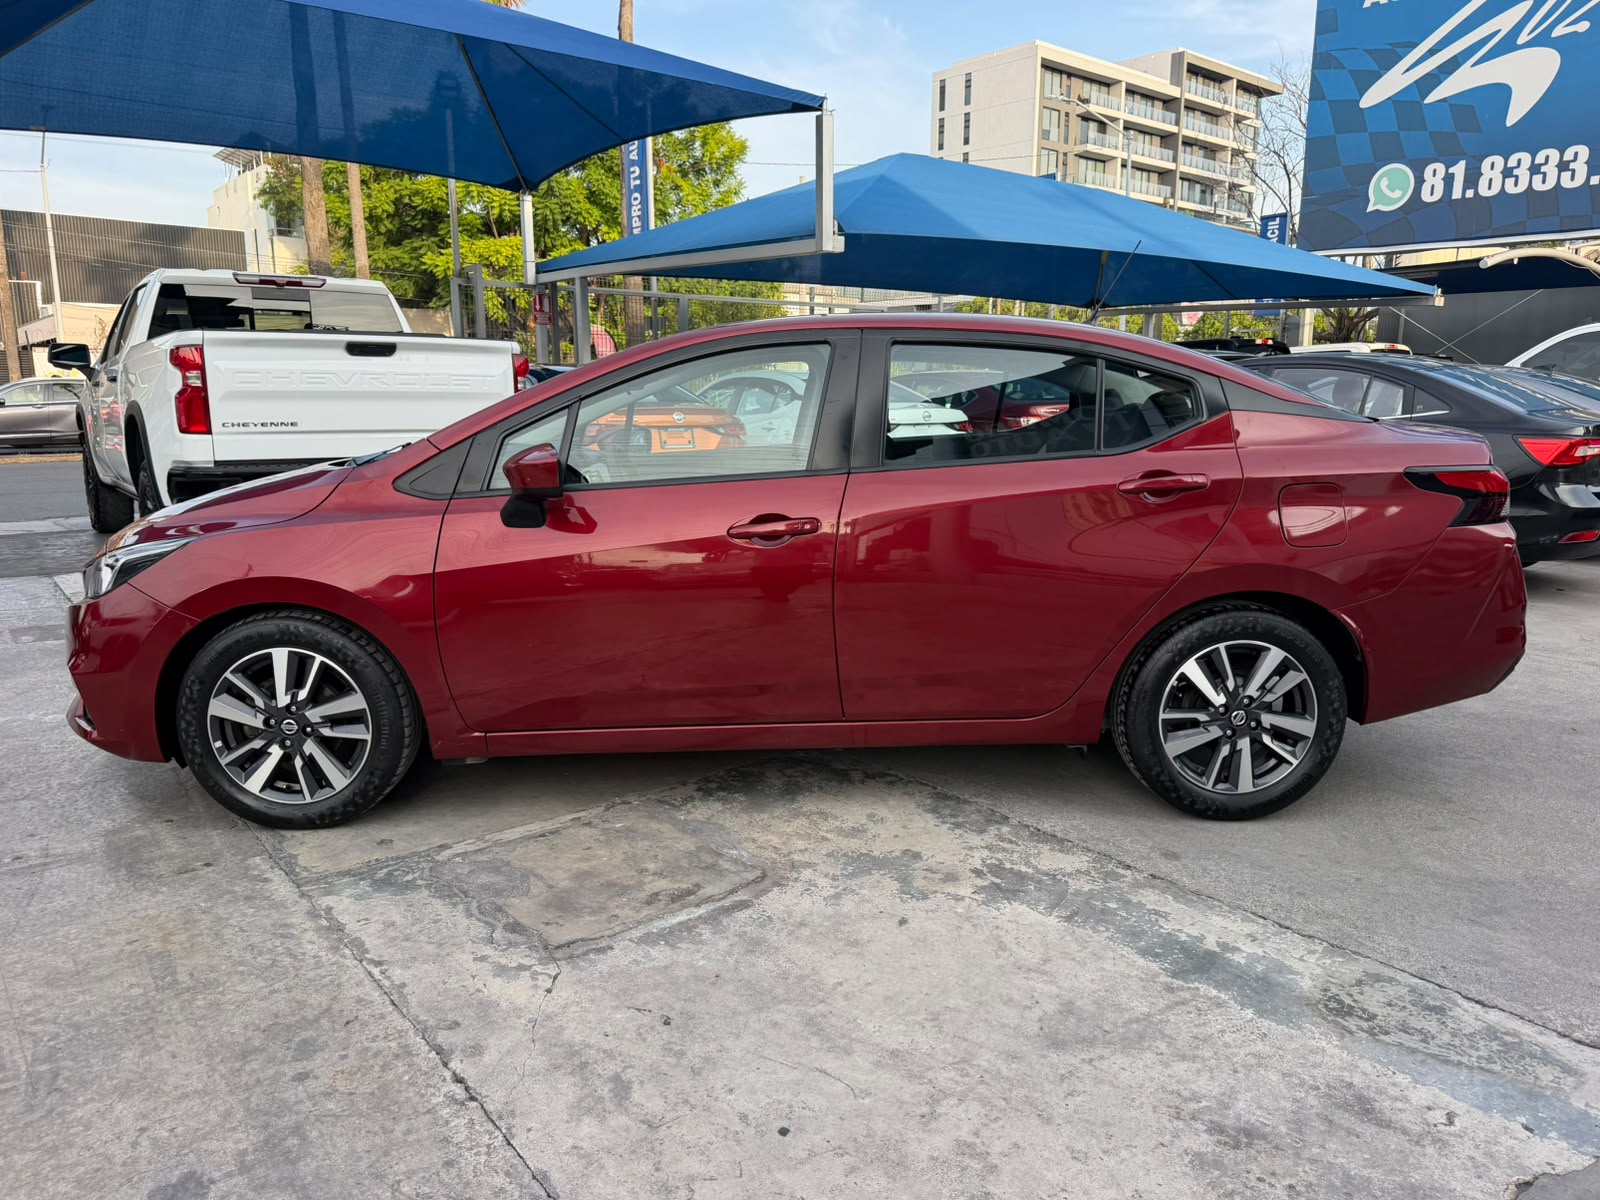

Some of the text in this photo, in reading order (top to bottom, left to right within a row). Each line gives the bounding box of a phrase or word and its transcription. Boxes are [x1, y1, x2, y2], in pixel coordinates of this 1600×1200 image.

[630, 166, 641, 190] TU
[1420, 144, 1600, 203] 81.8333.
[231, 371, 498, 390] CHEVROLET
